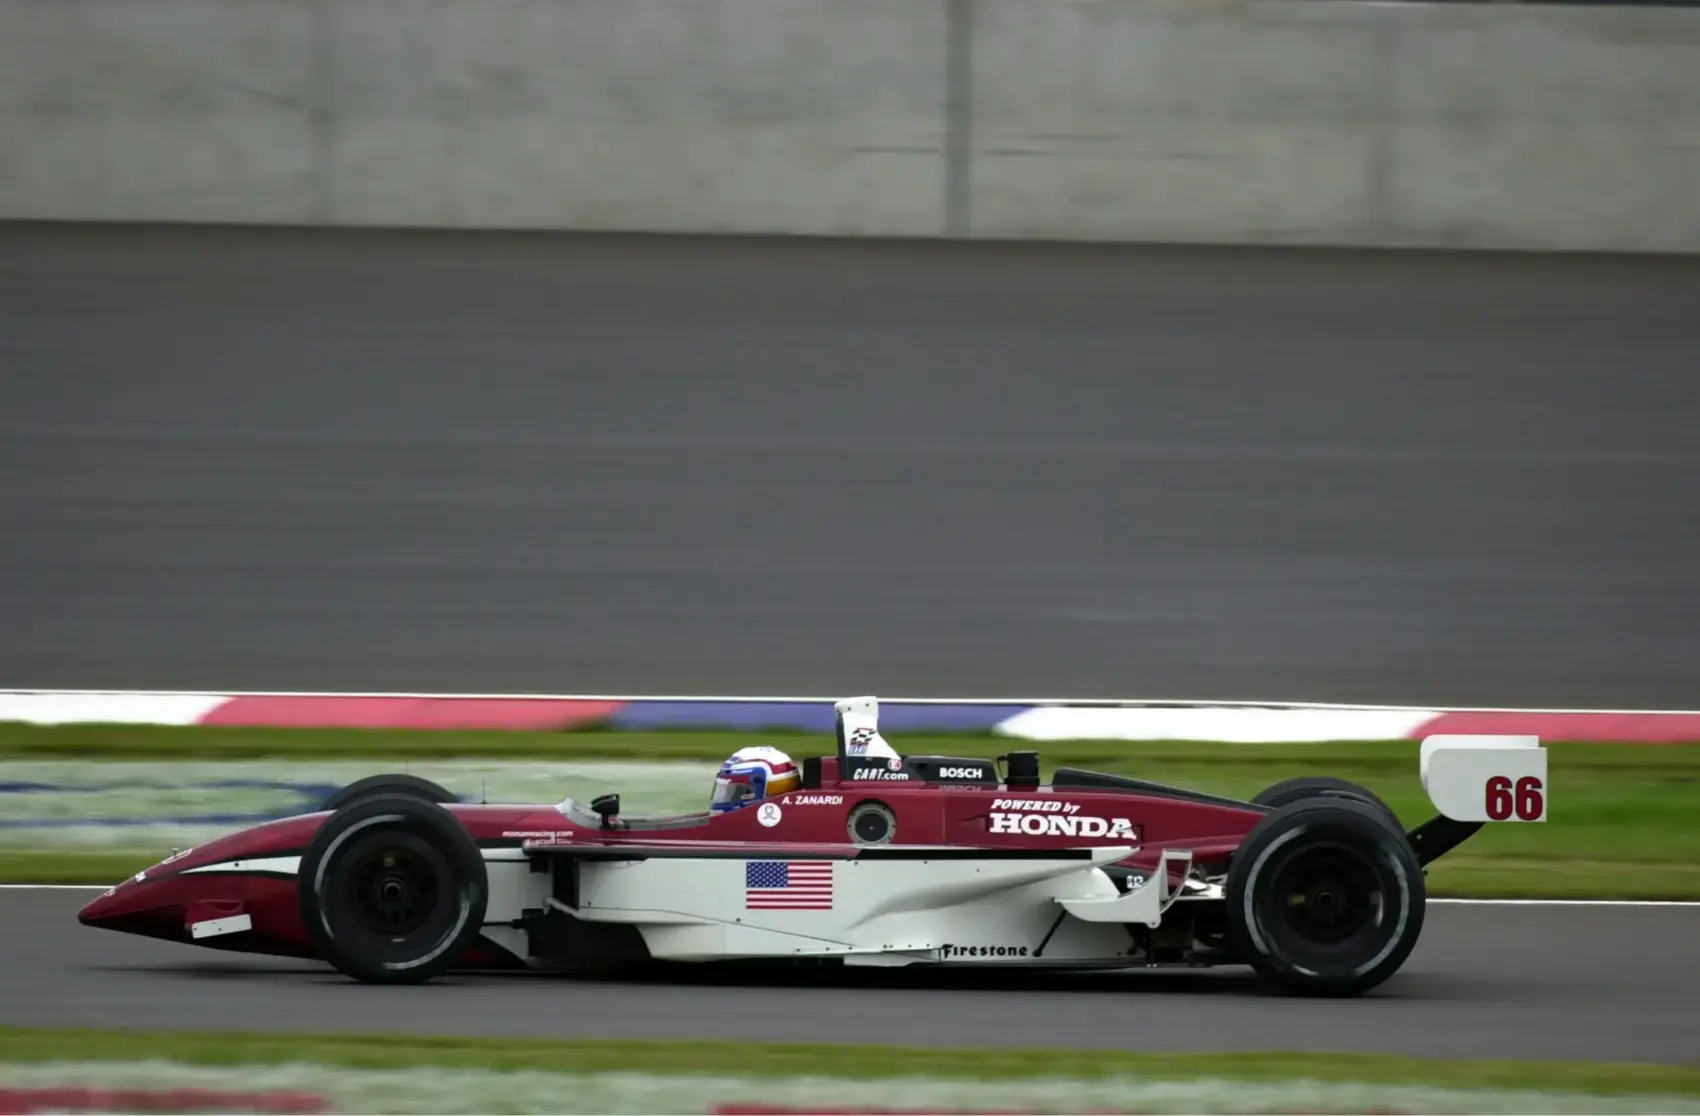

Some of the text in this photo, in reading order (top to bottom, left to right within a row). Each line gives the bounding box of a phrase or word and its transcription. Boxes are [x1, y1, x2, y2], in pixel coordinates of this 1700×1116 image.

[853, 768, 909, 780] CART.com
[939, 767, 983, 779] BOSCH
[781, 795, 844, 805] A. ZANARDI
[1485, 775, 1544, 821] 66
[990, 798, 1081, 815] POWERED by
[989, 812, 1137, 840] HONDA
[941, 943, 1029, 959] Firestone
